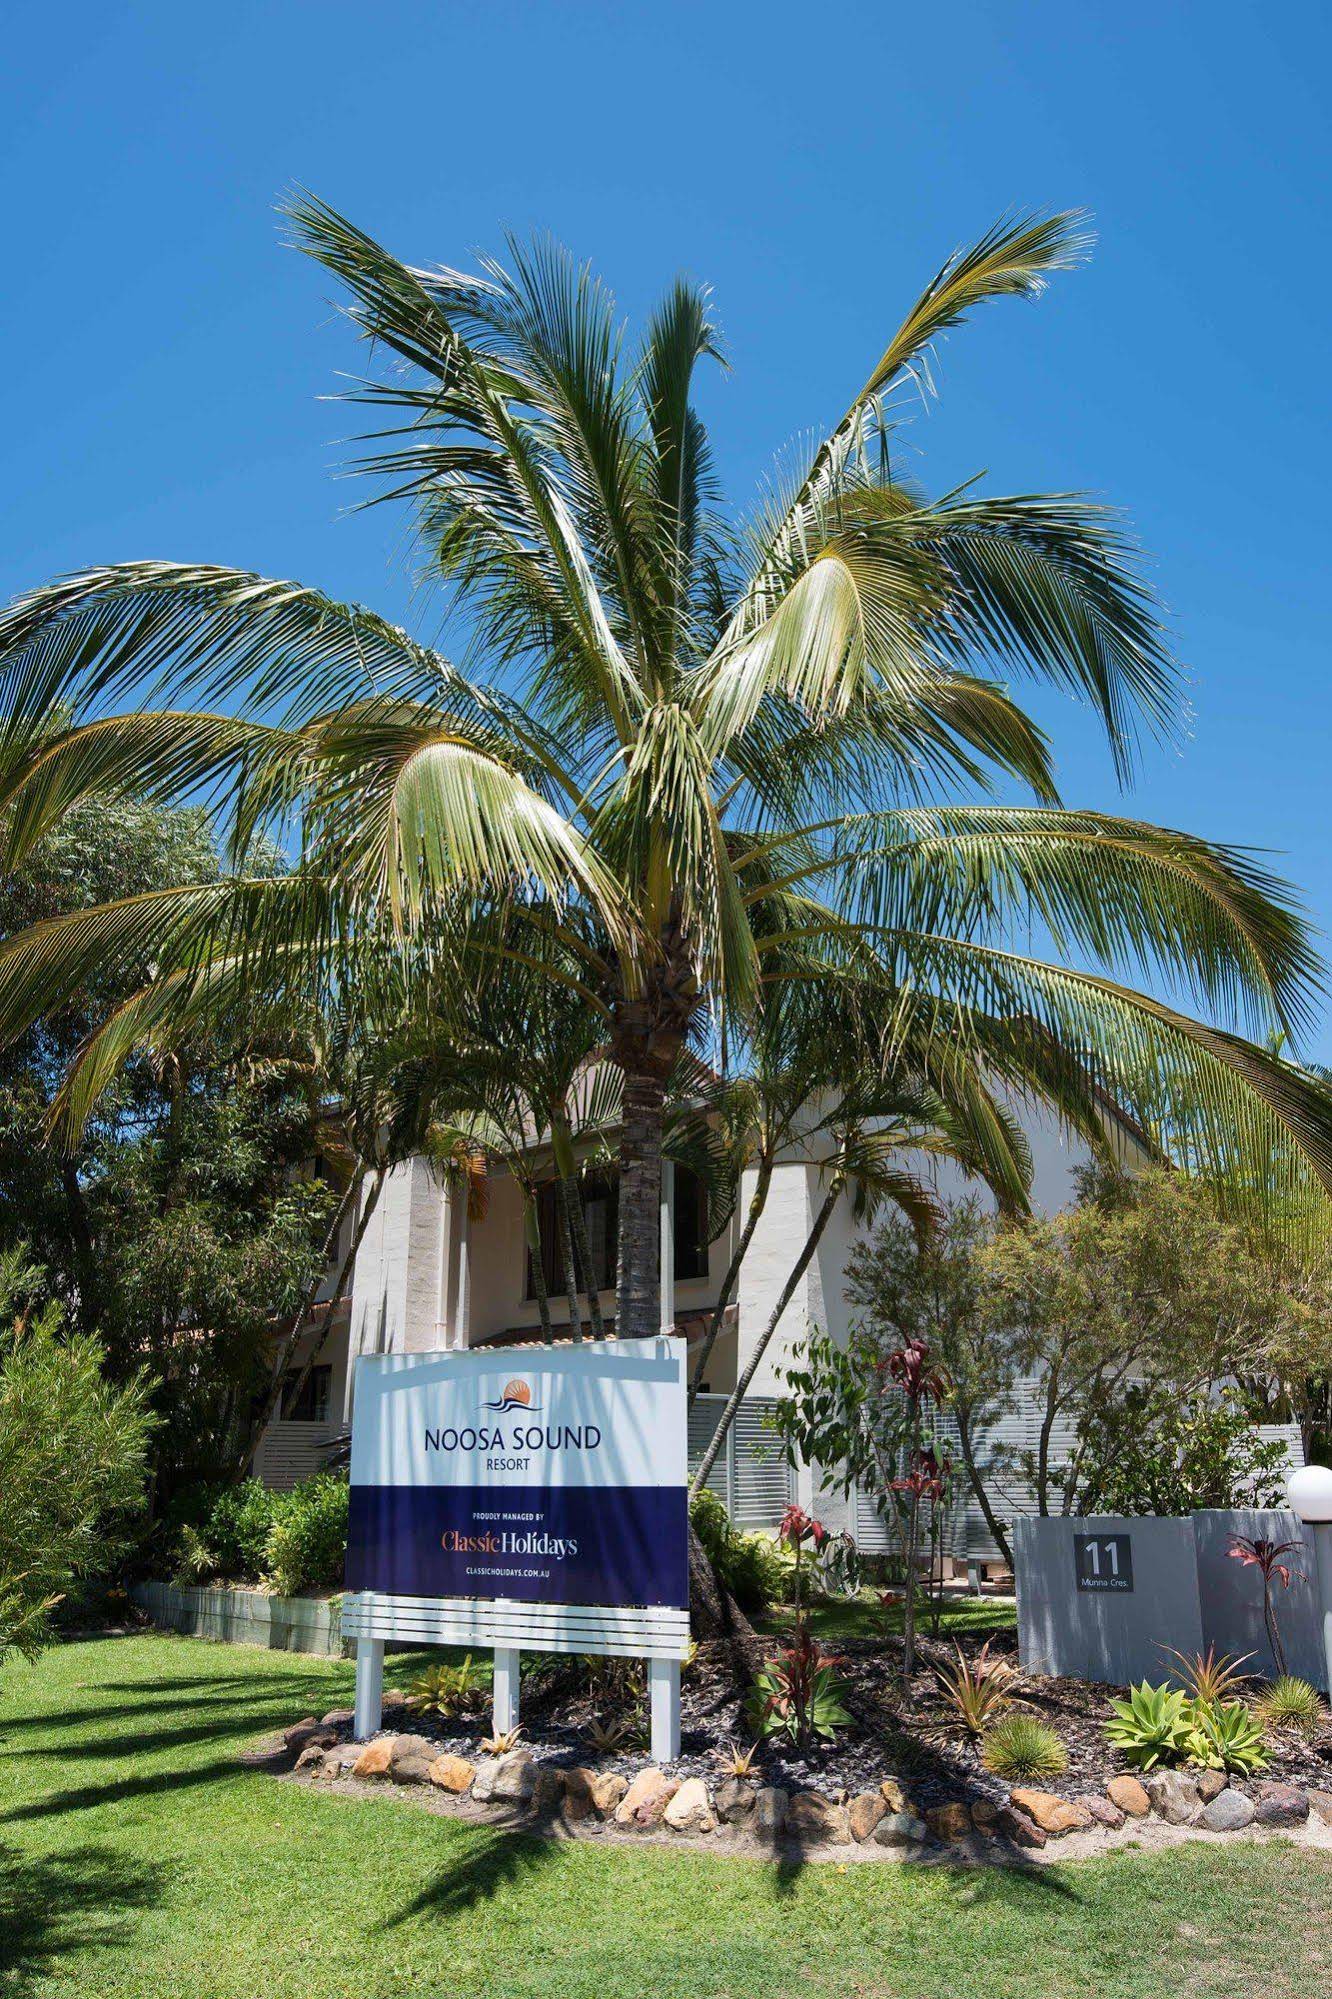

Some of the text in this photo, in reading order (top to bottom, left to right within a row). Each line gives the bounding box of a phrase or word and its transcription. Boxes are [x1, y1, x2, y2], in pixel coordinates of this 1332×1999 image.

[424, 1425, 602, 1451] NOOSA SOUND
[486, 1458, 530, 1471] RESORT
[472, 1512, 545, 1521] PROUDLY MANAGED BY
[1085, 1541, 1119, 1575] 11
[465, 1566, 550, 1578] CLASSICHOLIDAYS.COM.AU
[1081, 1578, 1108, 1587] Munna
